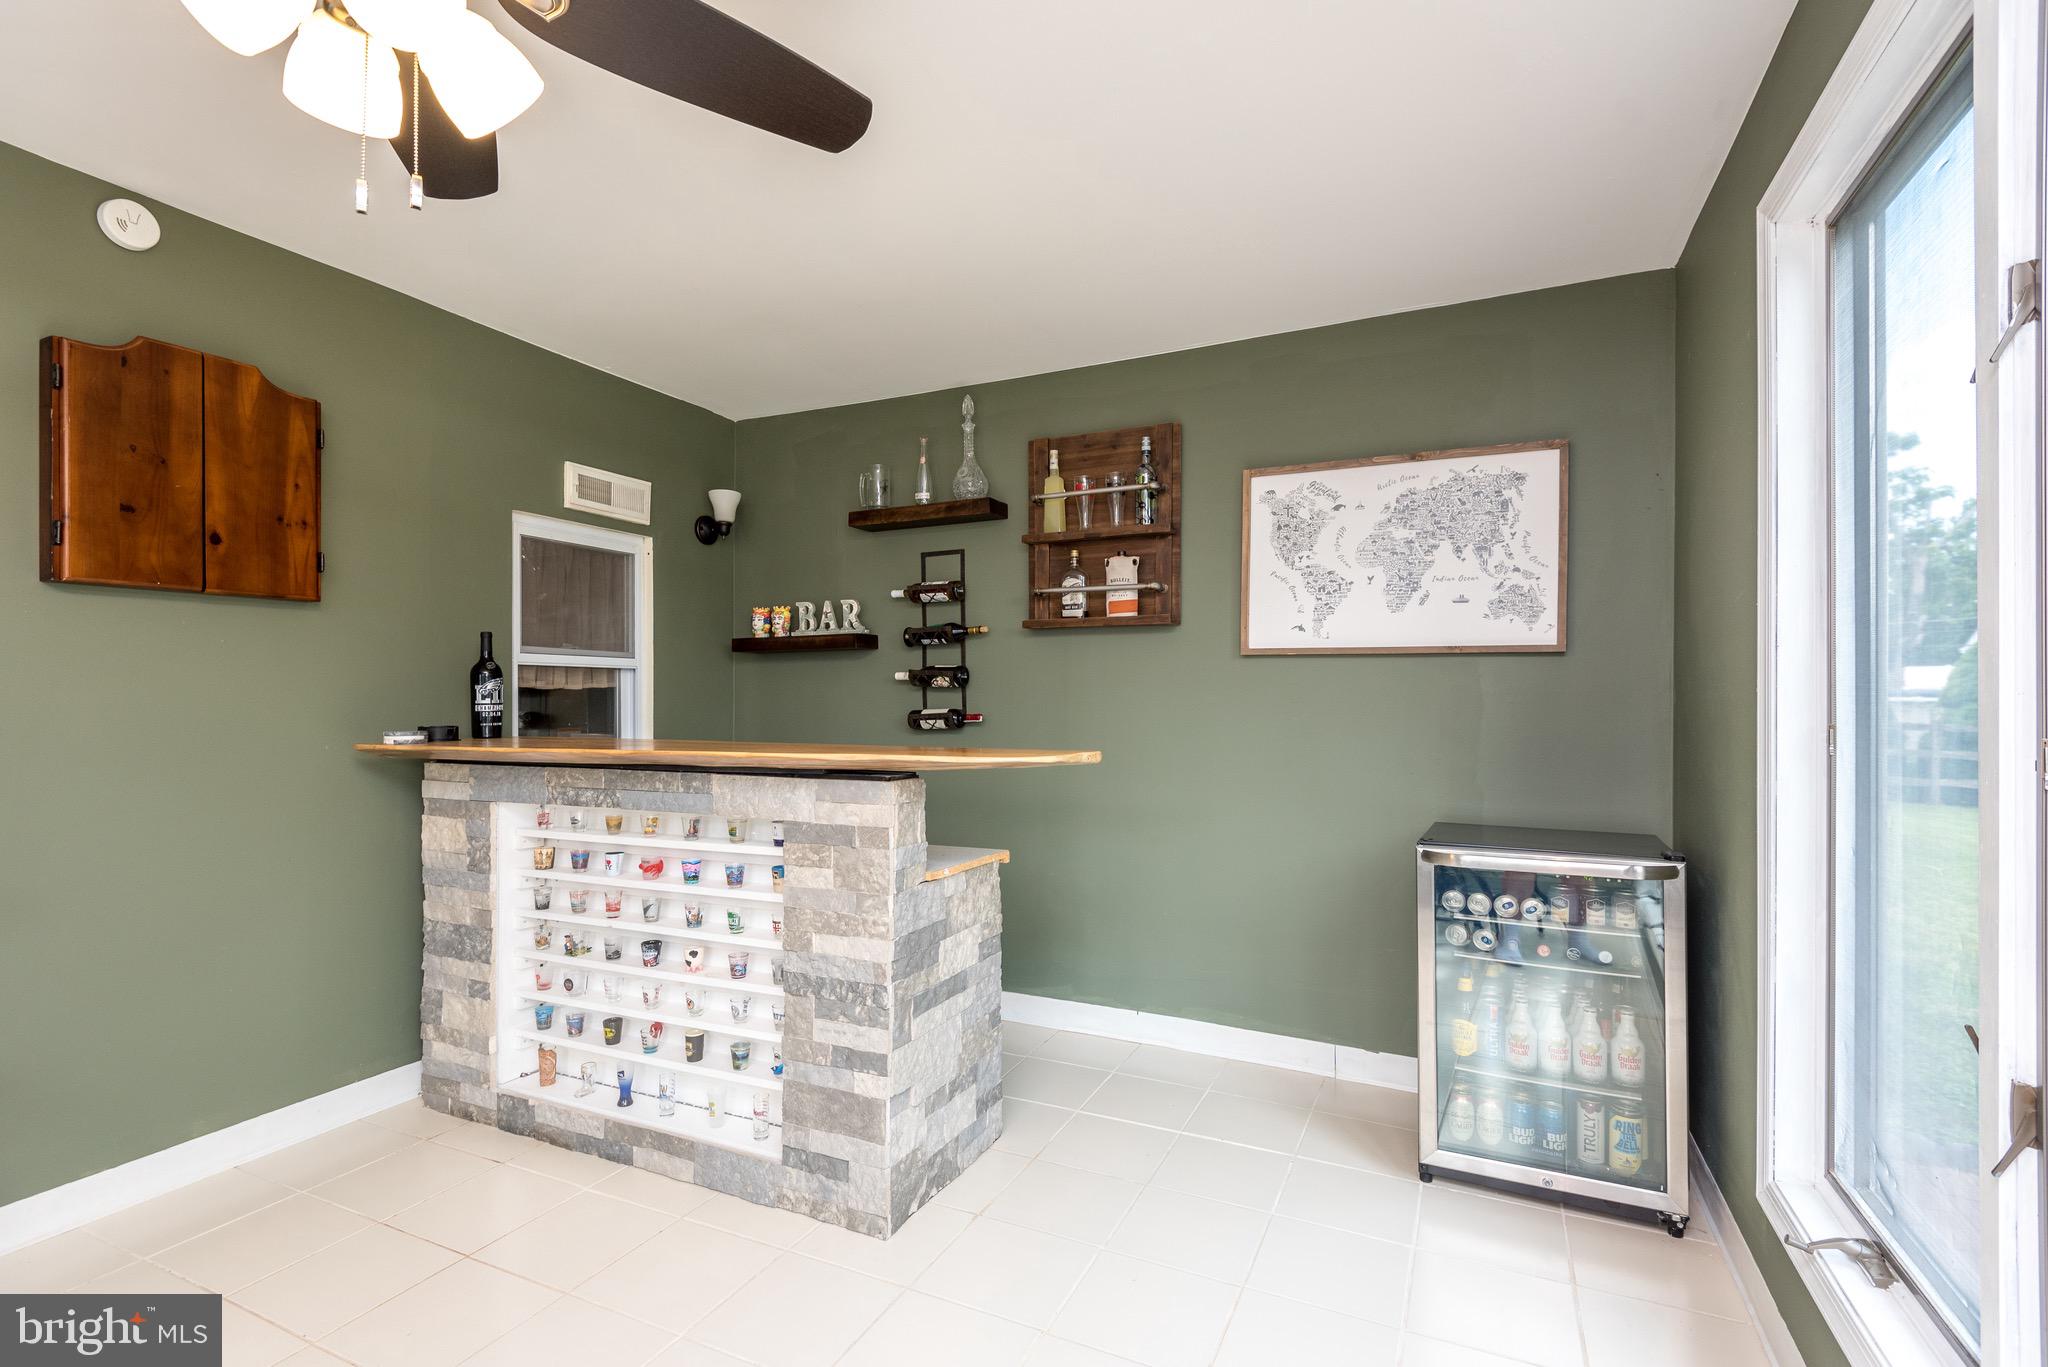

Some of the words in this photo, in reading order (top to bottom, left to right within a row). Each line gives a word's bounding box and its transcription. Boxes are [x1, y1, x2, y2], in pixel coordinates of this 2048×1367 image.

[792, 599, 868, 636] BAR
[1513, 1126, 1535, 1137] BUD
[1584, 1113, 1596, 1153] TRULY
[1615, 1120, 1641, 1134] RING
[1616, 1139, 1639, 1151] BELL
